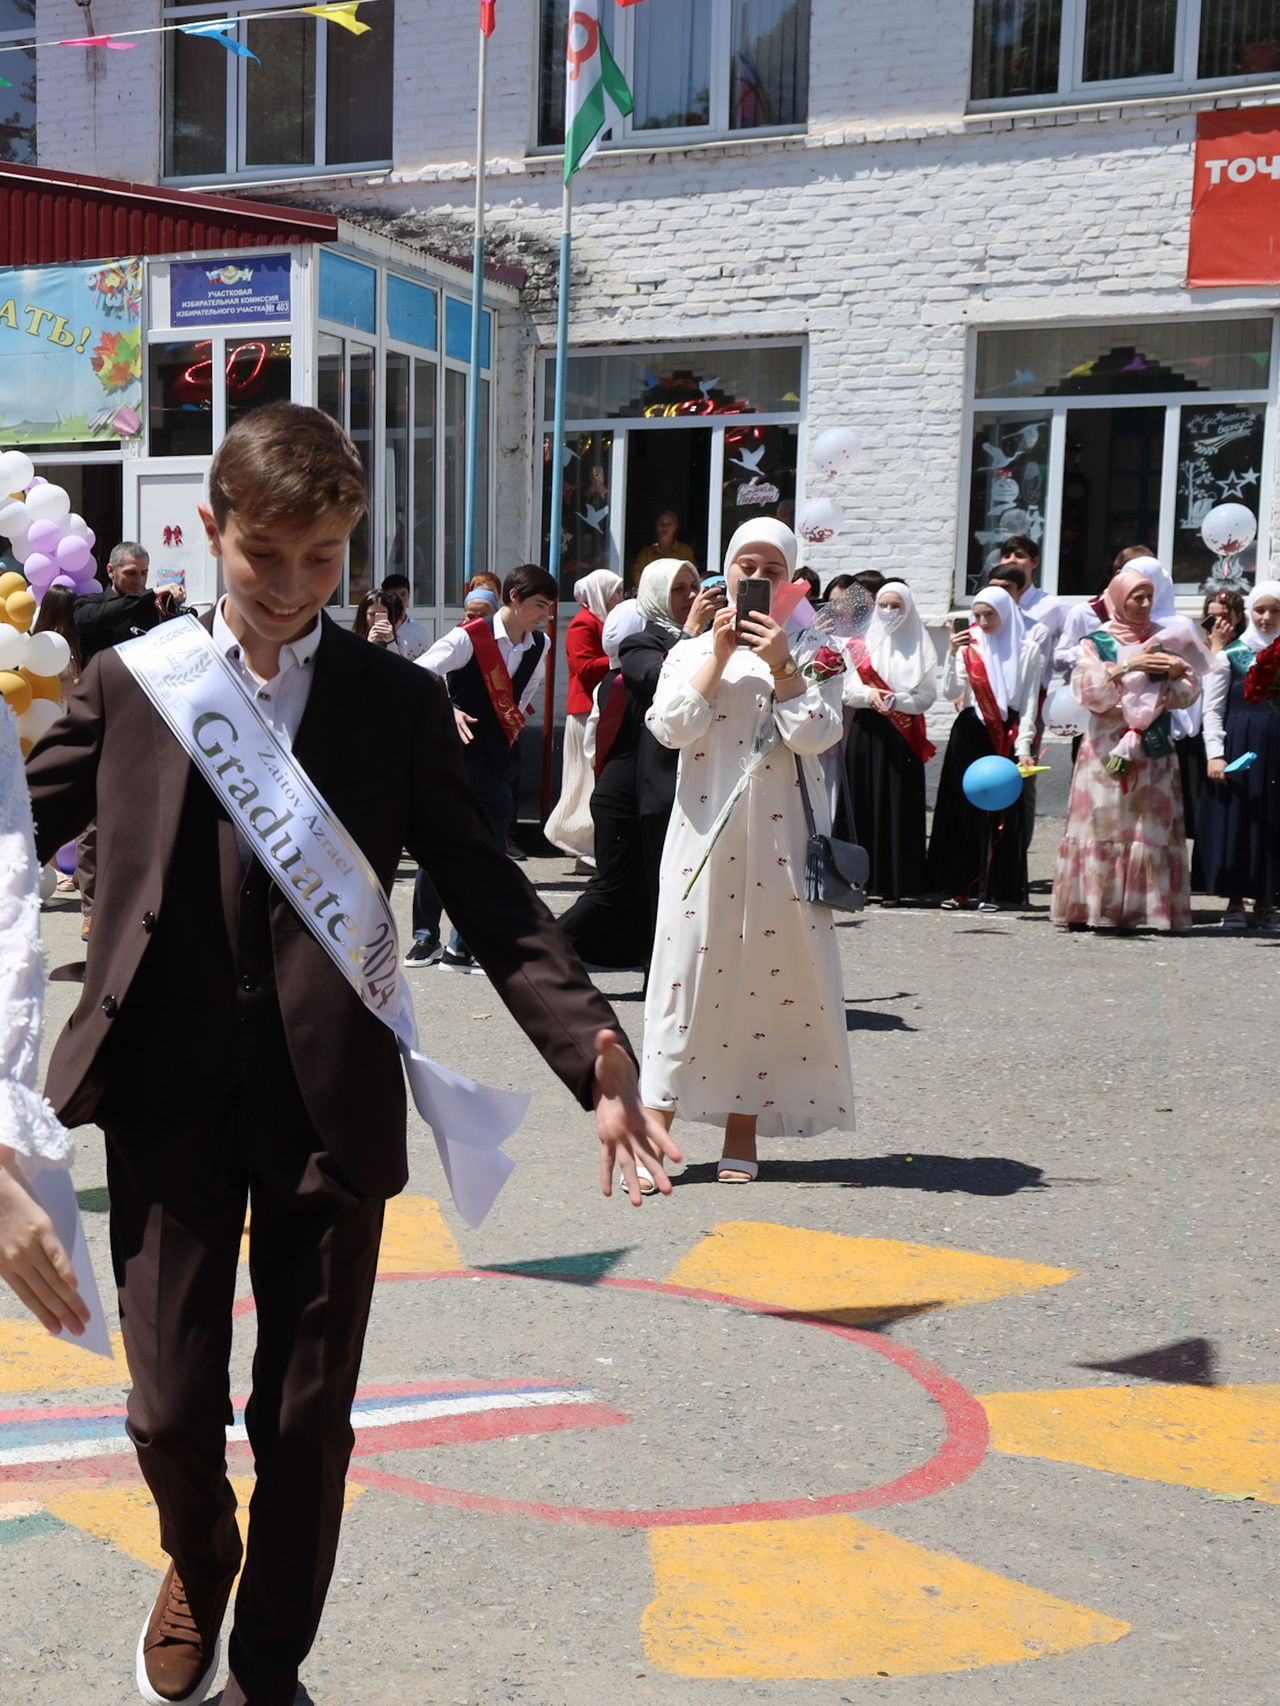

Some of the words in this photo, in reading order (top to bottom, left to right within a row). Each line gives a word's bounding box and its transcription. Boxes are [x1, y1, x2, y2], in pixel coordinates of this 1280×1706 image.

[176, 305, 236, 317] ИЗБИРАТЕЛЬНОГО
[236, 304, 266, 313] УЧАСТКА
[266, 303, 275, 312] №
[276, 302, 289, 312] 403
[181, 298, 240, 308] ИЗБИРАТЕЛЬНАЯ
[240, 294, 279, 304] КОМИССИЯ
[207, 288, 253, 298] УЧАСТКОВАЯ
[192, 711, 357, 949] Graduate
[256, 745, 305, 810] Zaitov
[301, 810, 356, 878] Azrael
[347, 922, 399, 1012] 2024
